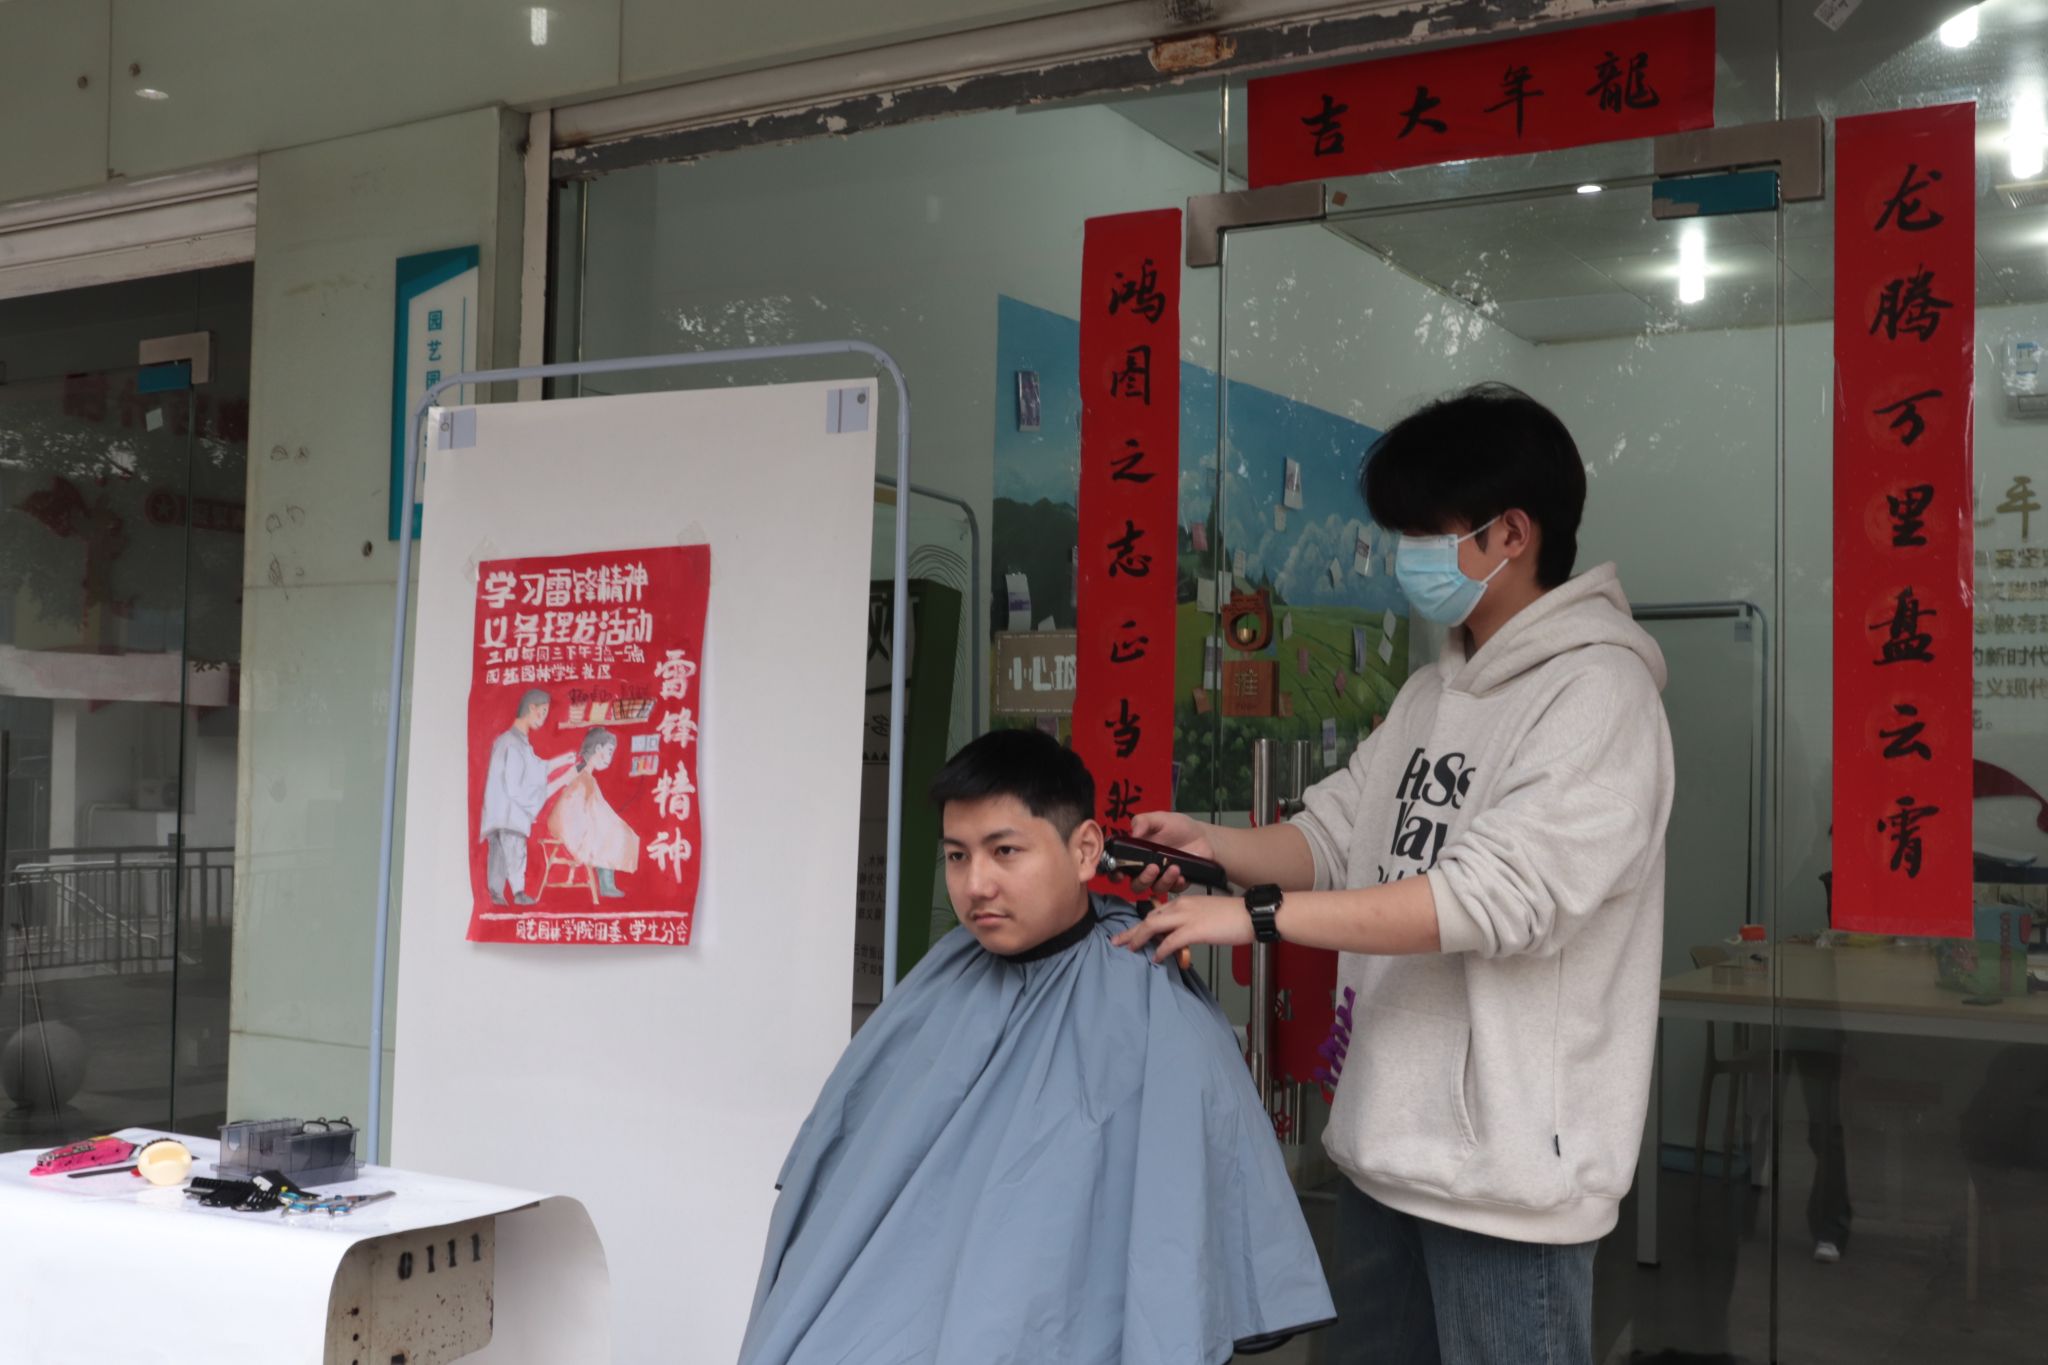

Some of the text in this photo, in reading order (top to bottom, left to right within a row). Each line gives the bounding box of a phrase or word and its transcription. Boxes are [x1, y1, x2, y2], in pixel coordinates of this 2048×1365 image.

[1868, 163, 1954, 880] 龙腾万里盘云霄
[482, 561, 649, 608] 学习雷锋精神
[480, 608, 653, 648] 义务理发活动
[646, 649, 698, 884] 雷锋精神
[398, 1233, 481, 1280] 0111
